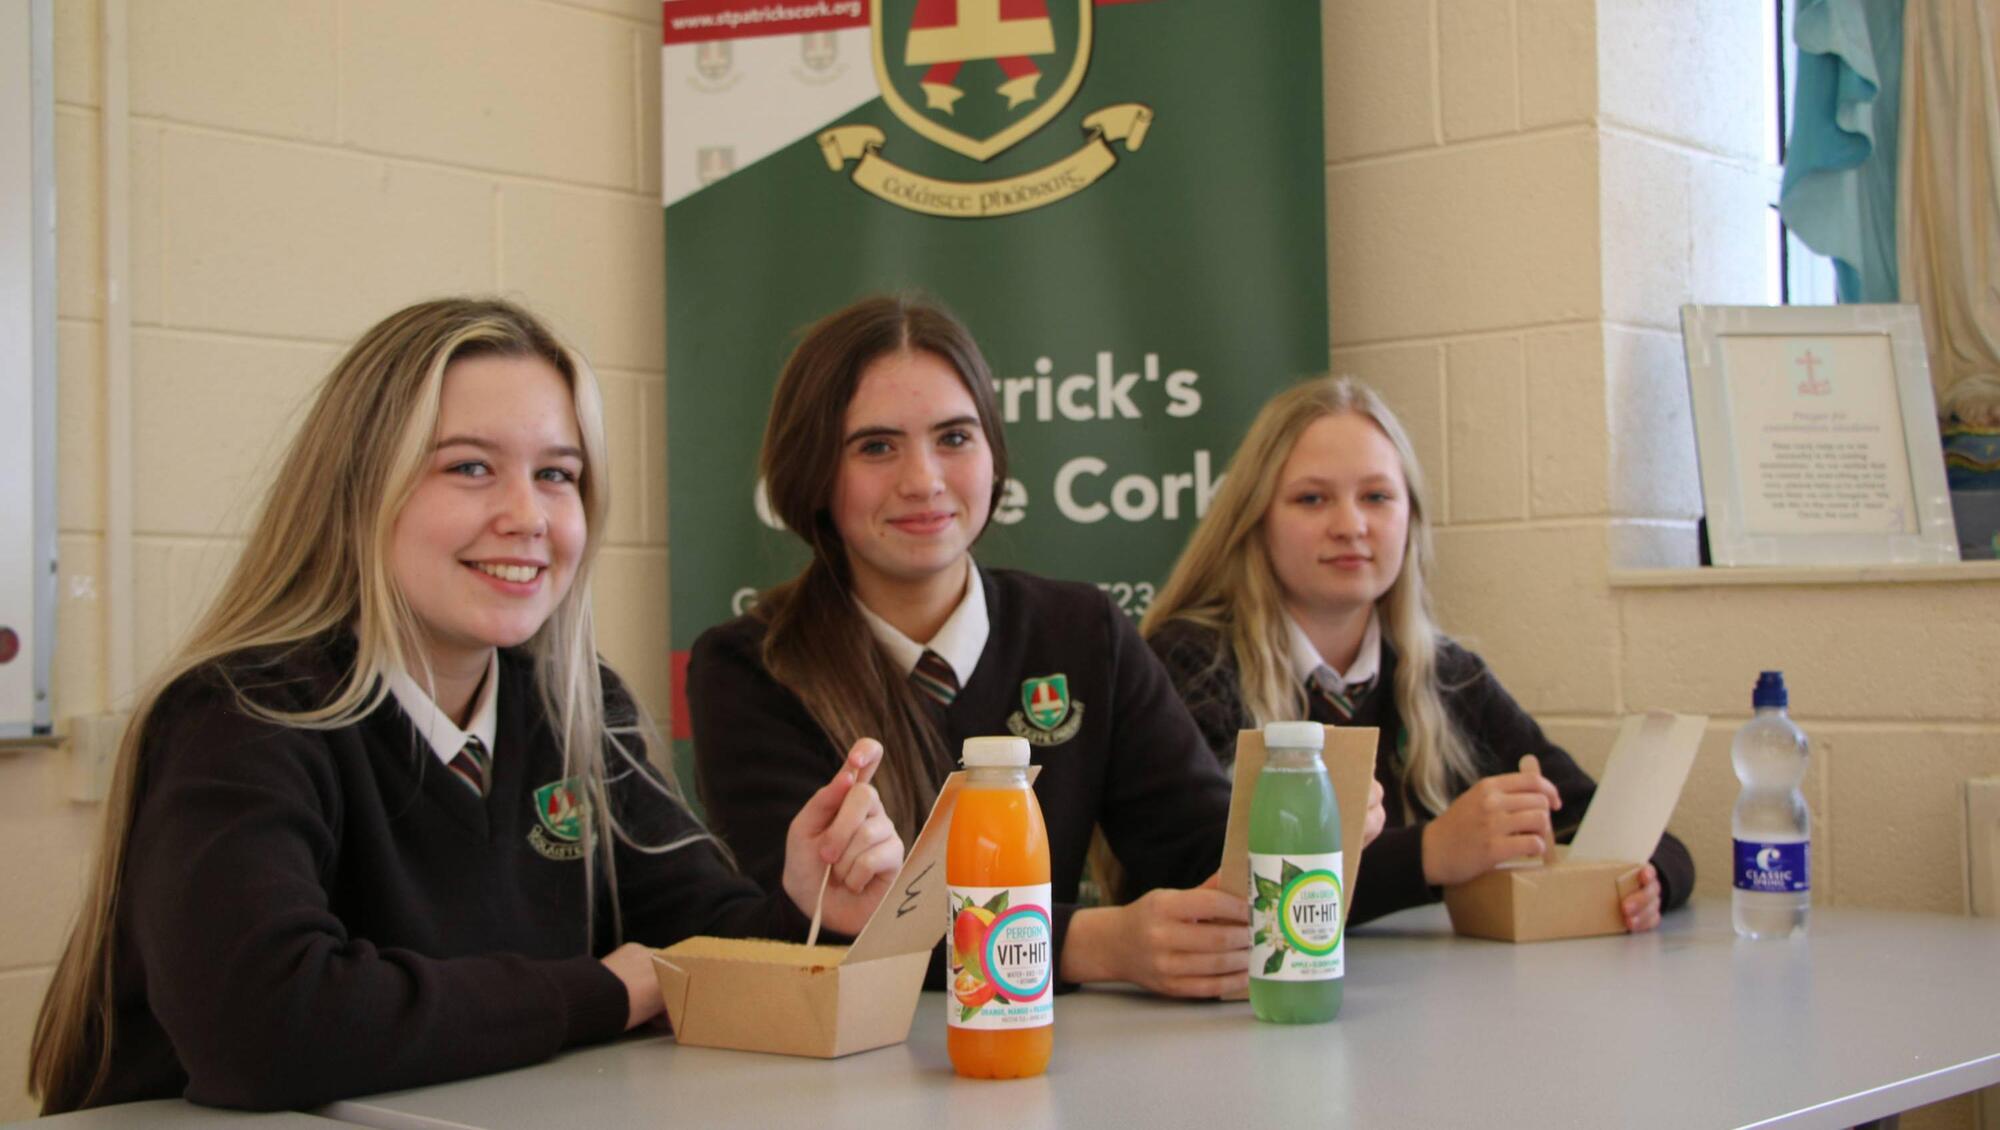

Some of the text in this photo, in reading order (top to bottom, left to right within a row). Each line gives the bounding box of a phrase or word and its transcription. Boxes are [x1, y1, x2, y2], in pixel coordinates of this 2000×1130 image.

[671, 1, 862, 30] www.stpatrickscork.org
[992, 352, 1202, 423] rick's
[1745, 869, 1793, 881] CLASSIC
[1006, 926, 1043, 939] PERFORM
